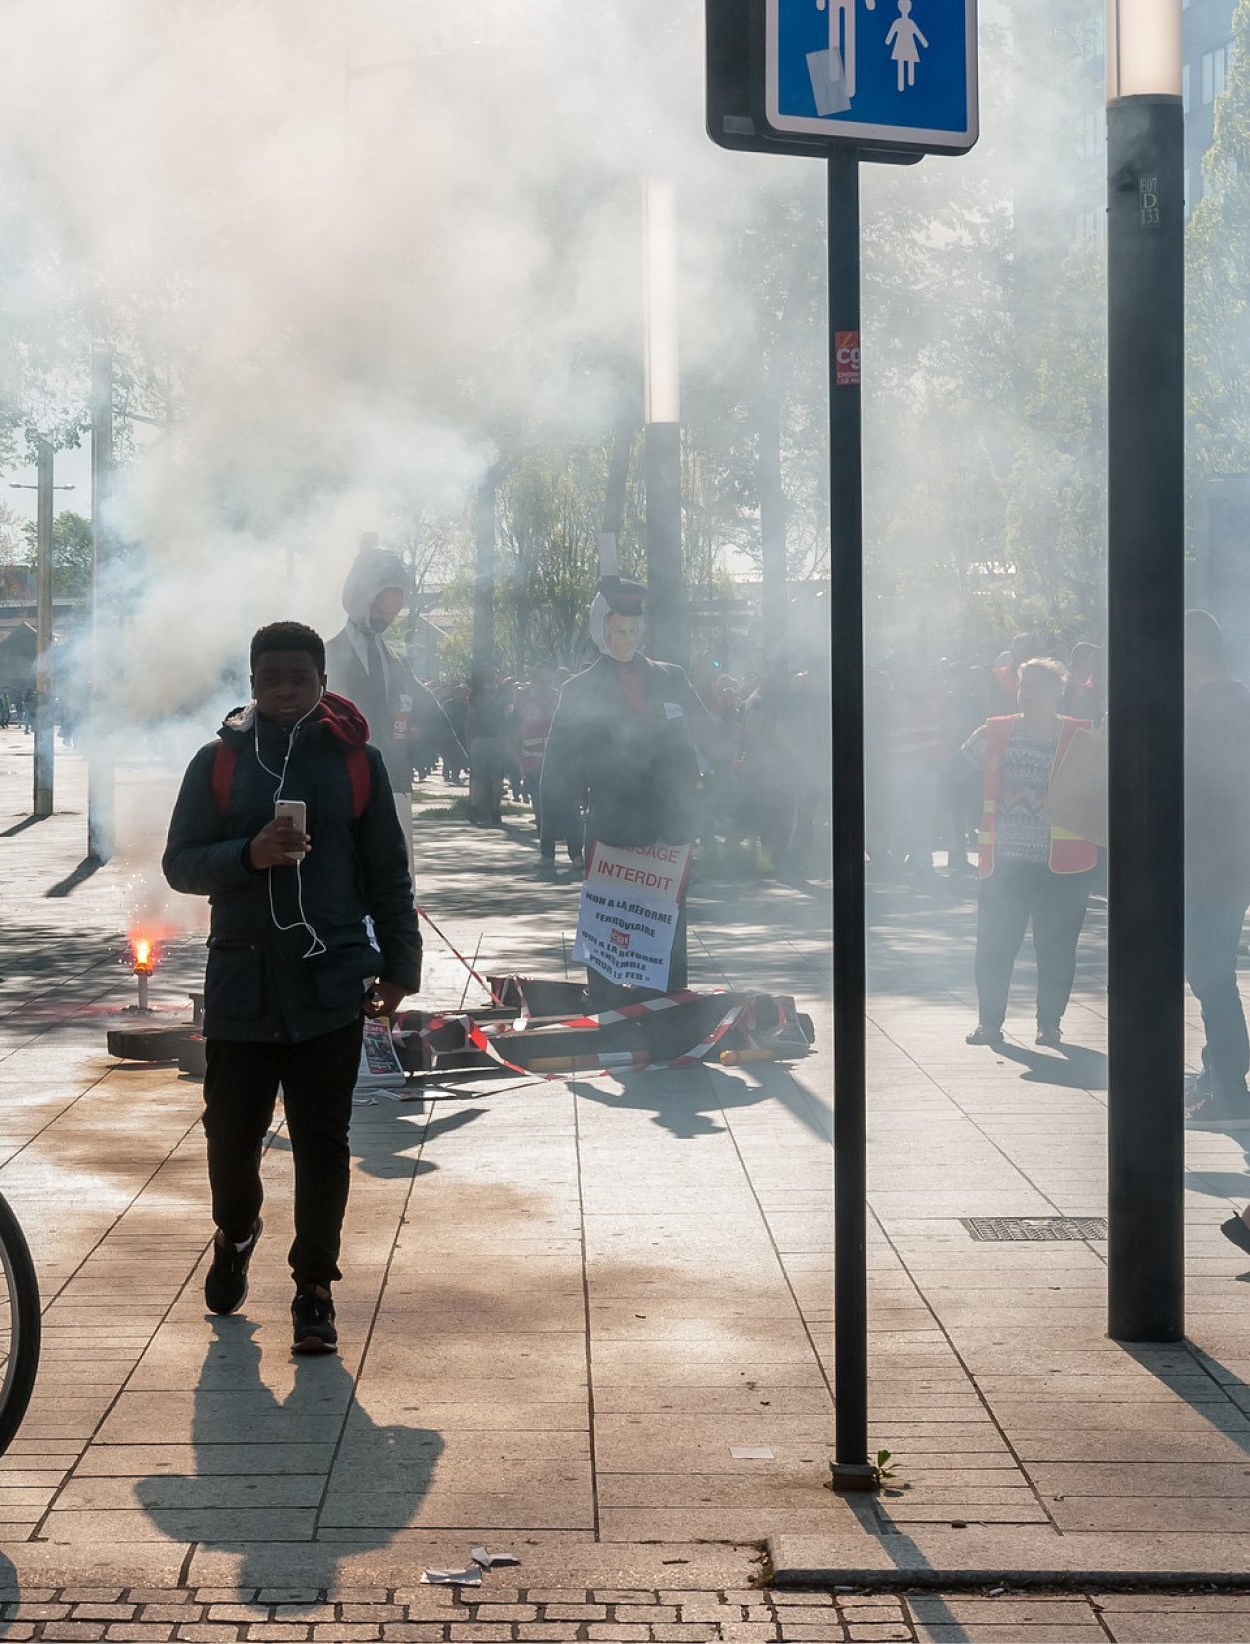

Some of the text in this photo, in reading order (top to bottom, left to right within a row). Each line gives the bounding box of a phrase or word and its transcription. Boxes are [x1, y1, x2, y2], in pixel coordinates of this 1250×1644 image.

[597, 859, 674, 890] INTERDIT
[586, 891, 607, 906] NON
[595, 912, 656, 938] FERROVIAIRE
